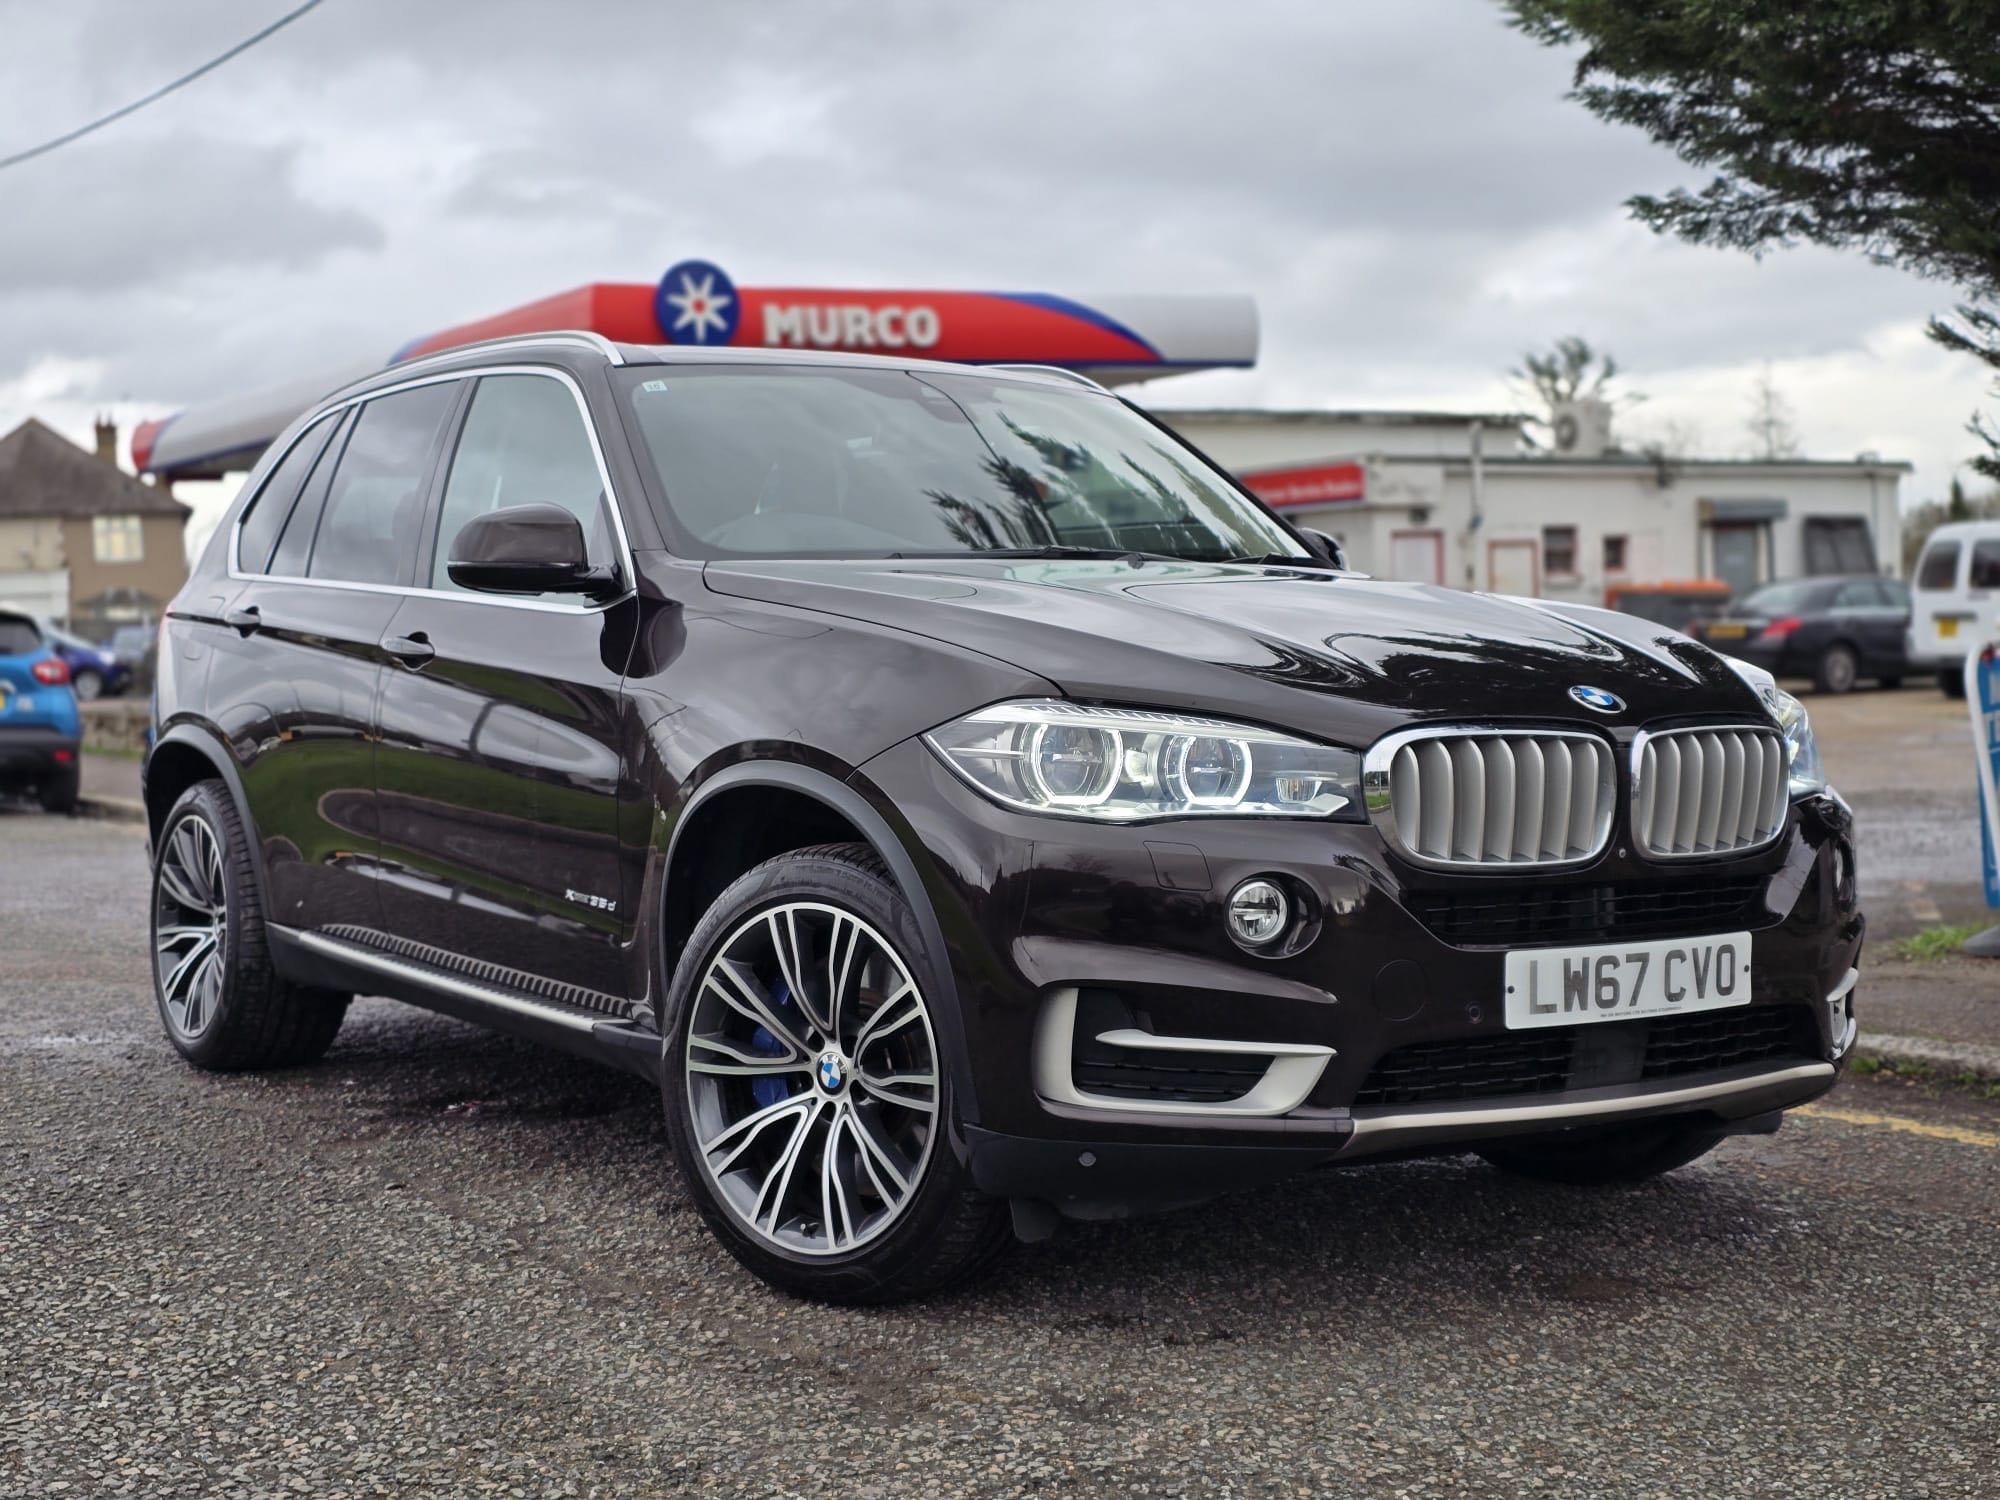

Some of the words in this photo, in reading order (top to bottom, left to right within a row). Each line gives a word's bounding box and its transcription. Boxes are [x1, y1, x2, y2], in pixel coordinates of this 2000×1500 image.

[763, 304, 940, 347] MURCO
[1529, 952, 1650, 1014] LW67
[1664, 944, 1736, 1002] CVO
